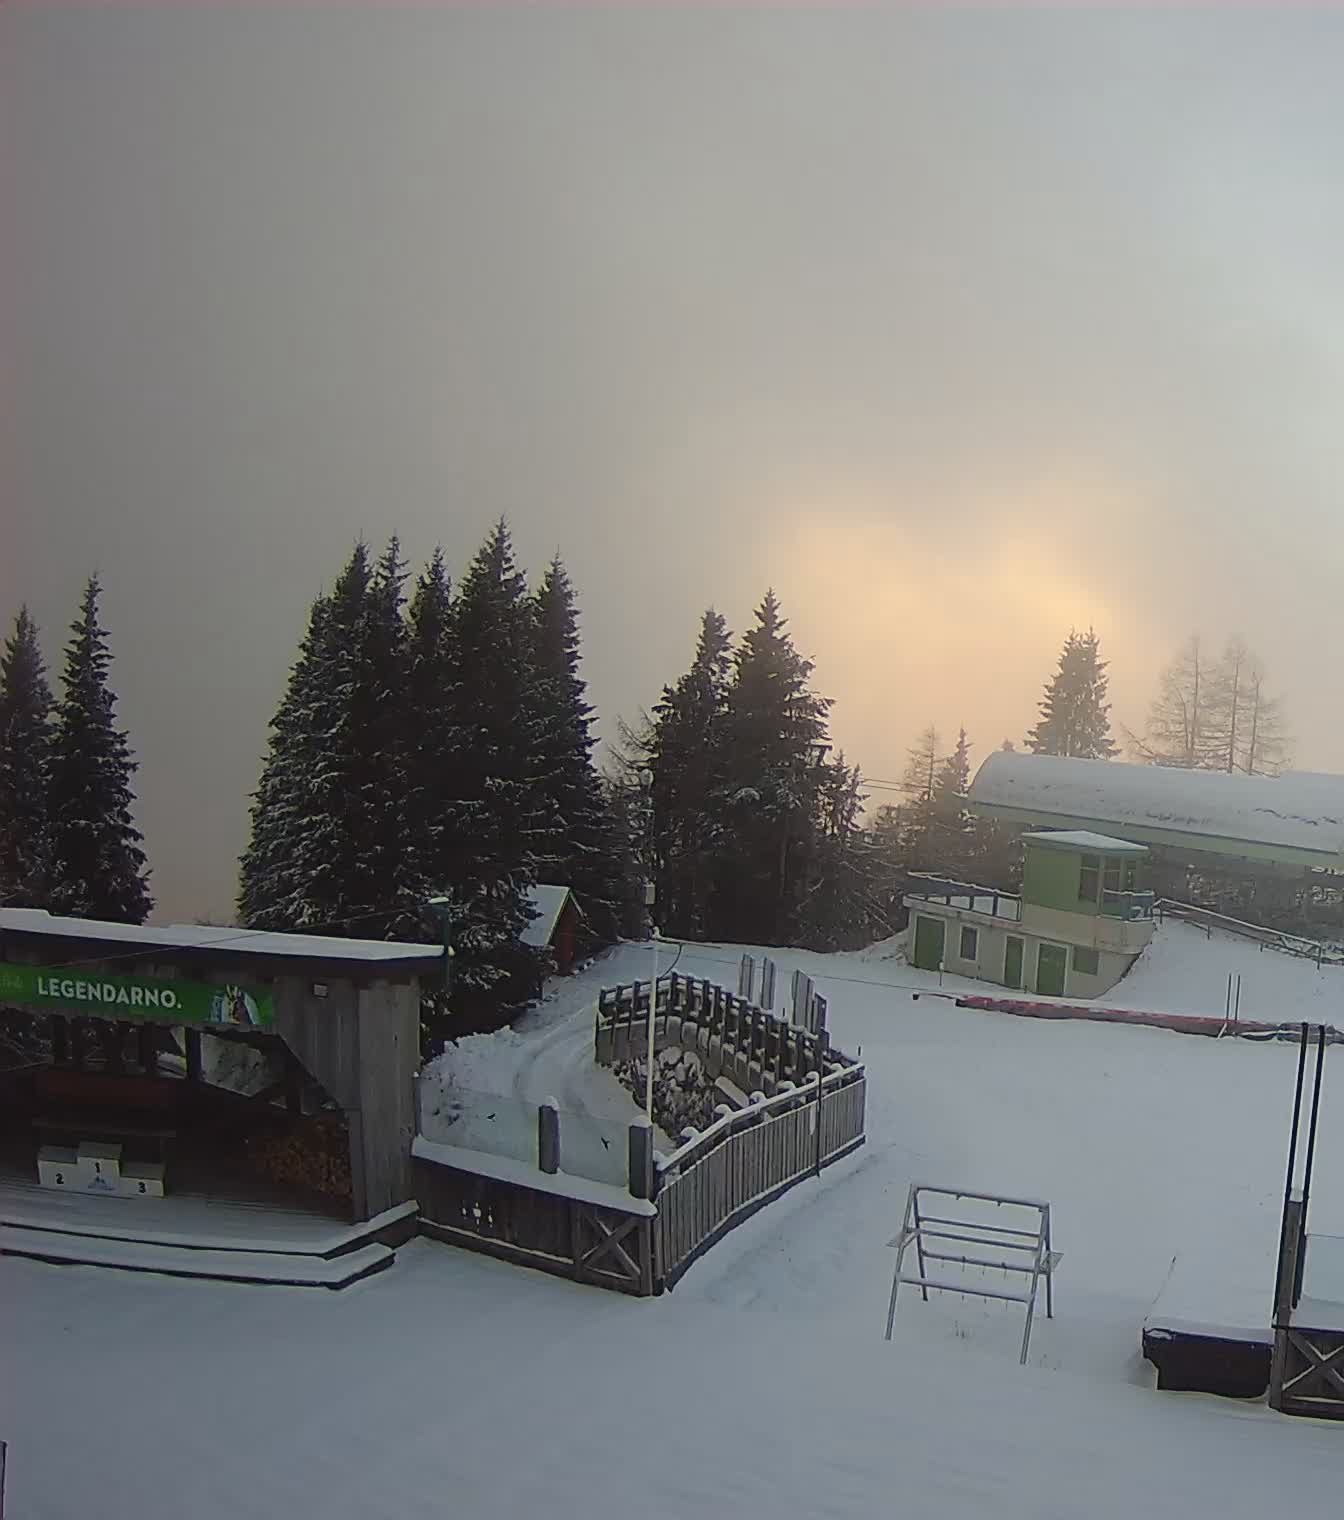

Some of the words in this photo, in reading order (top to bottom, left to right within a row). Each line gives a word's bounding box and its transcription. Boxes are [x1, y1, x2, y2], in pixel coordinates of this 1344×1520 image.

[37, 977, 183, 1009] LEGENDARNO.
[94, 1162, 101, 1174] 1
[55, 1173, 65, 1185] 2
[137, 1182, 146, 1194] 3
